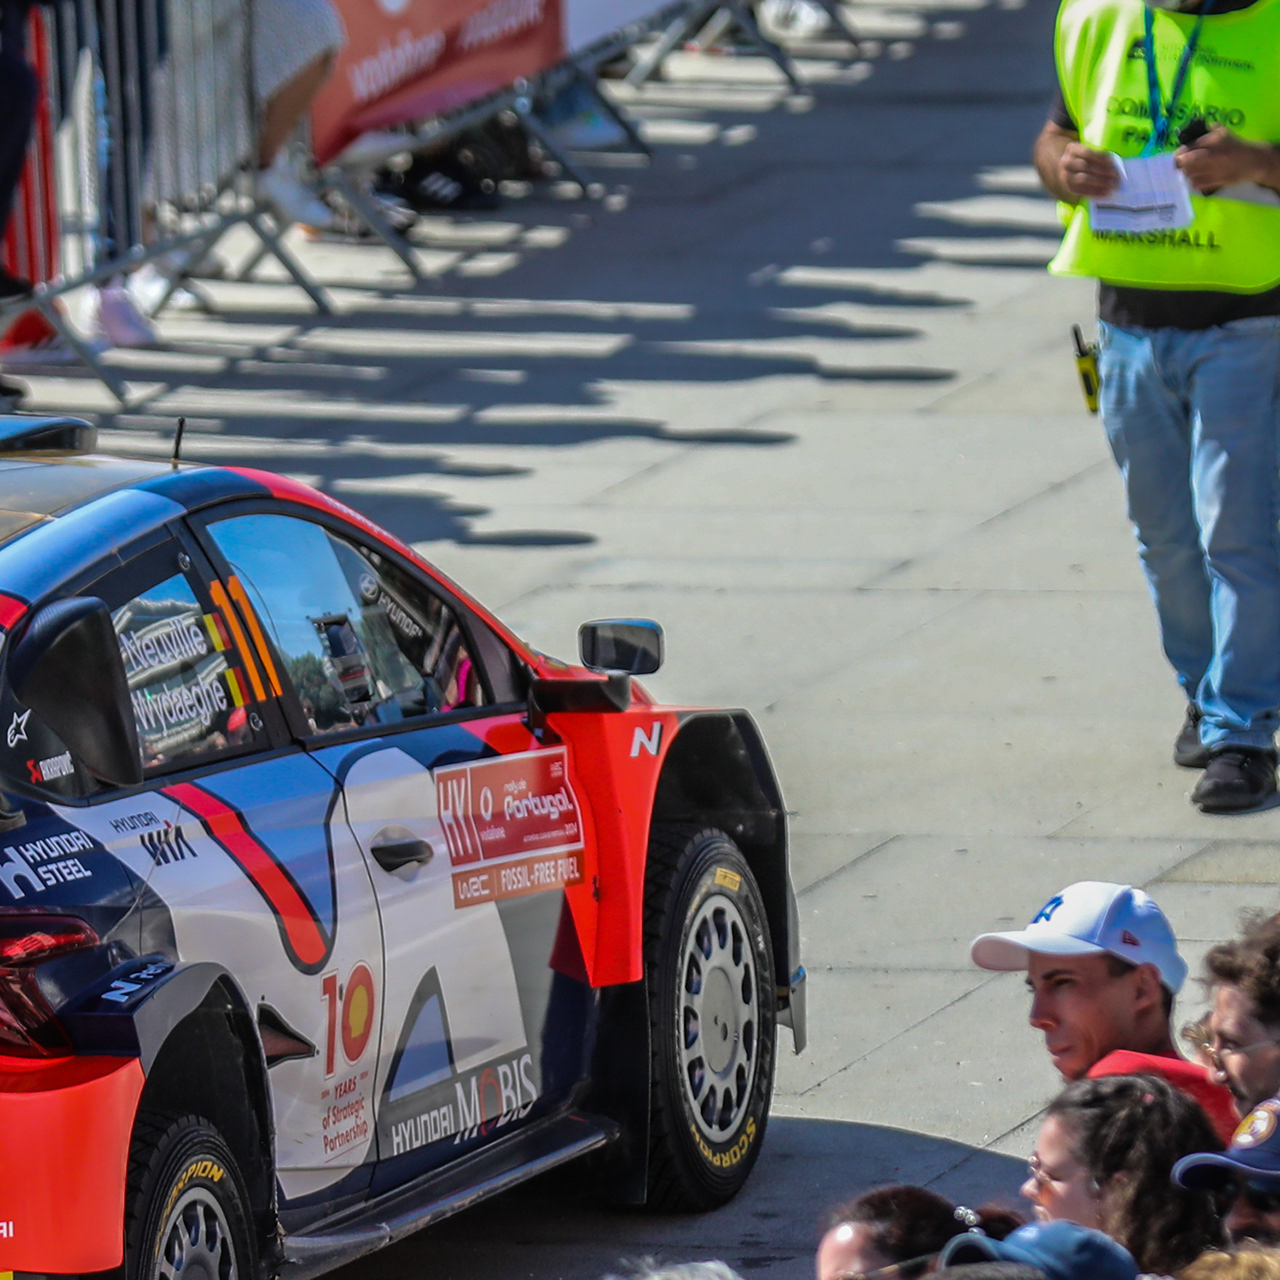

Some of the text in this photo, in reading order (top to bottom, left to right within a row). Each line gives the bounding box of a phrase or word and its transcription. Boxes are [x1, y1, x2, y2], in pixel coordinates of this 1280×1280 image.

[120, 617, 208, 671] Neuville
[208, 575, 283, 701] 11
[504, 786, 574, 821] Portugal
[109, 811, 161, 834] HYUNDAI
[18, 830, 94, 864] HYUNDAI
[139, 820, 198, 867] WIA
[37, 857, 93, 886] STEEL
[501, 858, 556, 892] FOSSIL-FREE
[558, 856, 580, 881] FUEL
[334, 1076, 357, 1101] YEARS
[391, 1053, 538, 1156] HYUNDAI MOBIS
[322, 1092, 365, 1131] of Strategic
[323, 1117, 369, 1155] Partnership
